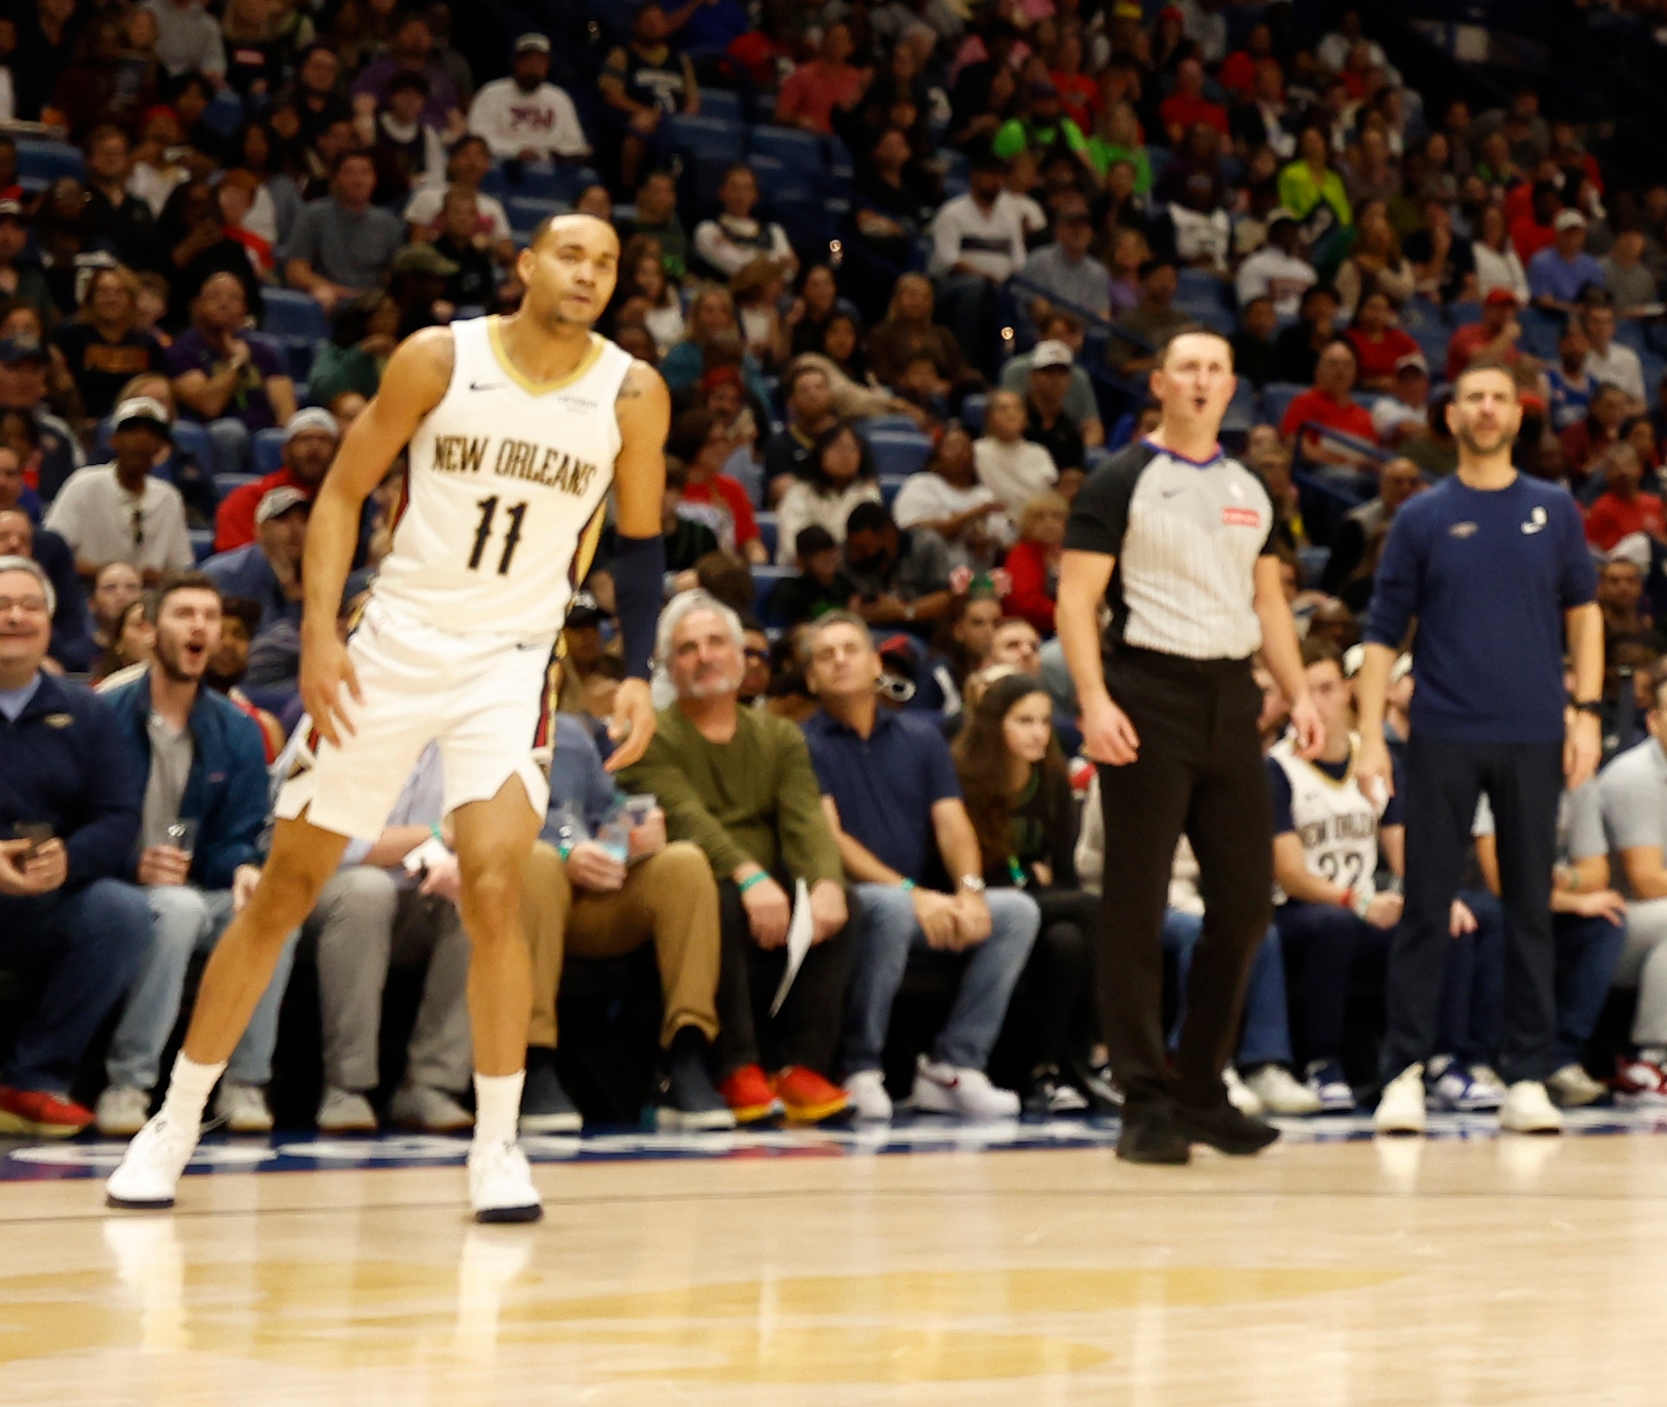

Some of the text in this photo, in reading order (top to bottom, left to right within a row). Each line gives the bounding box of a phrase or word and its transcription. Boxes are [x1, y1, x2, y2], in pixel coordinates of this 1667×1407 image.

[431, 435, 599, 498] NEW ORLEANS
[468, 494, 527, 575] 11
